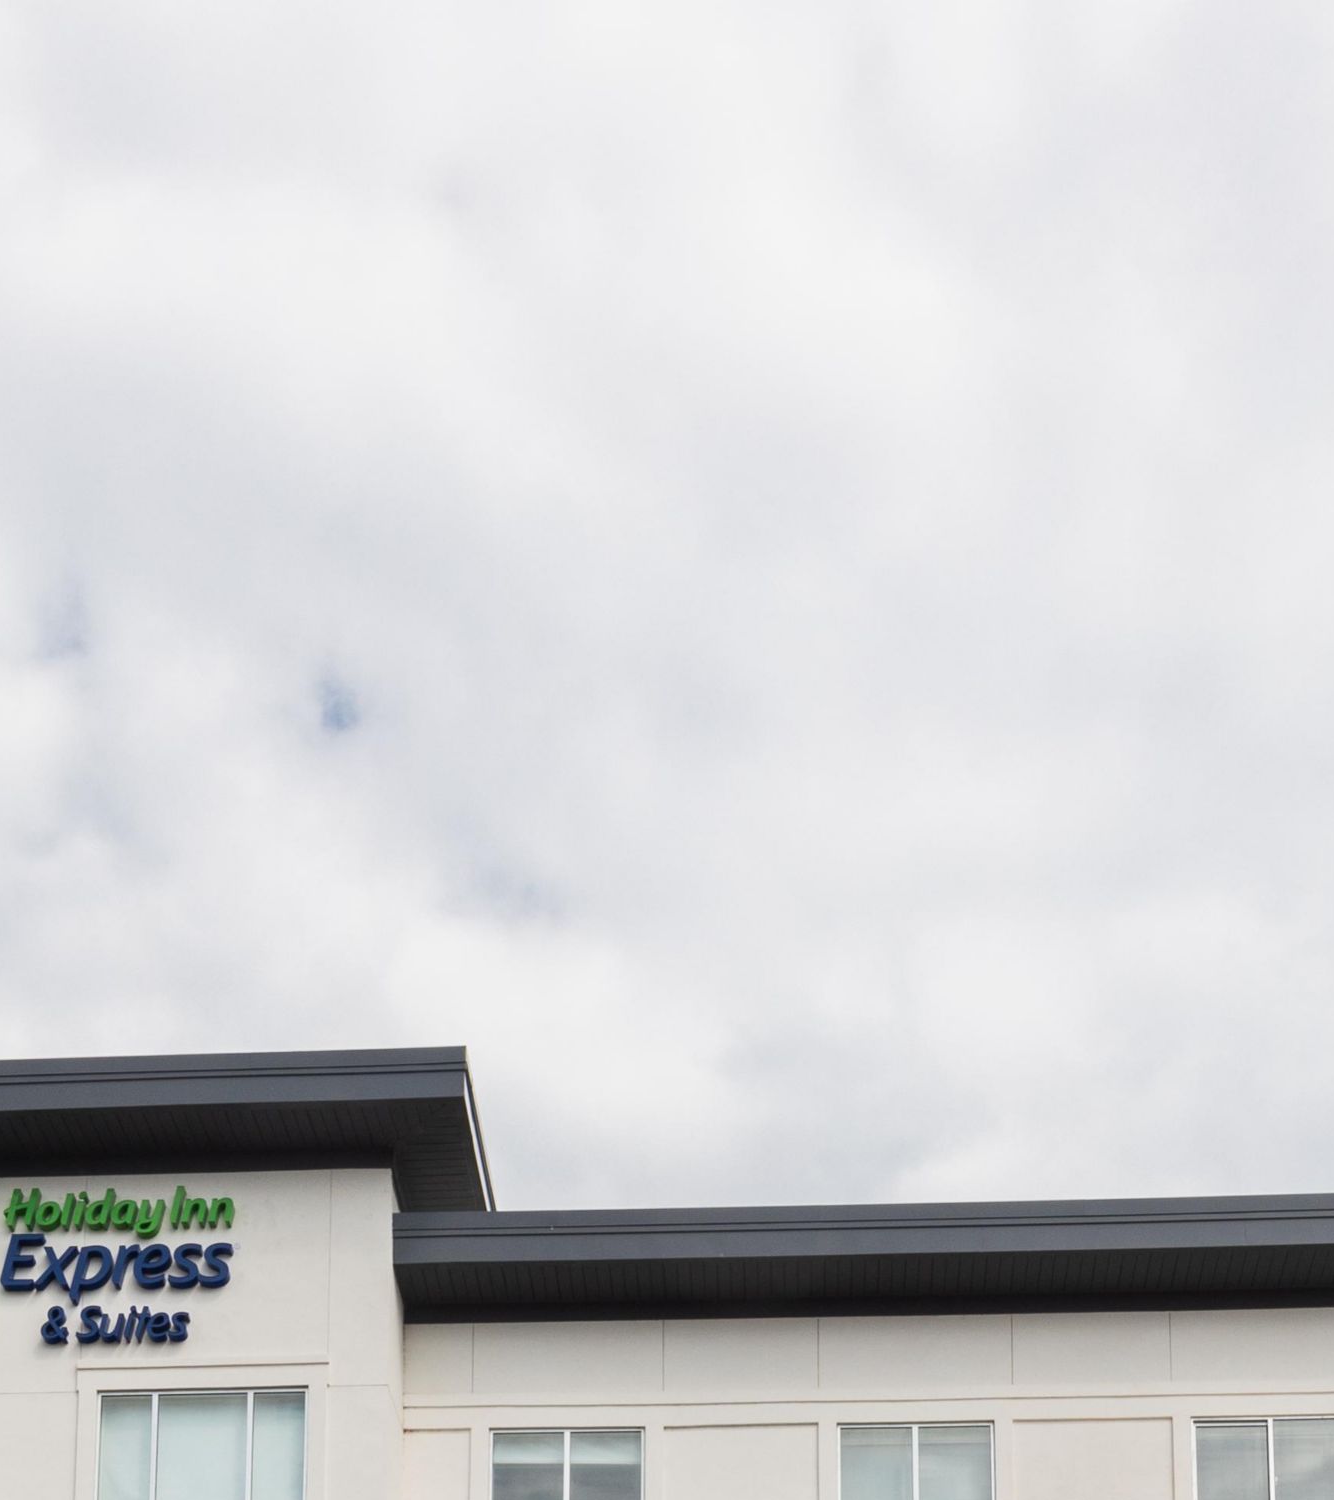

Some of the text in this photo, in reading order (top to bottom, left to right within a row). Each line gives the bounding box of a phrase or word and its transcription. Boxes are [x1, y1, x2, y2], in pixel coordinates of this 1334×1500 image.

[3, 1185, 235, 1239] Holiday Inn
[0, 1233, 234, 1306] Express
[40, 1305, 191, 1344] & Suites
